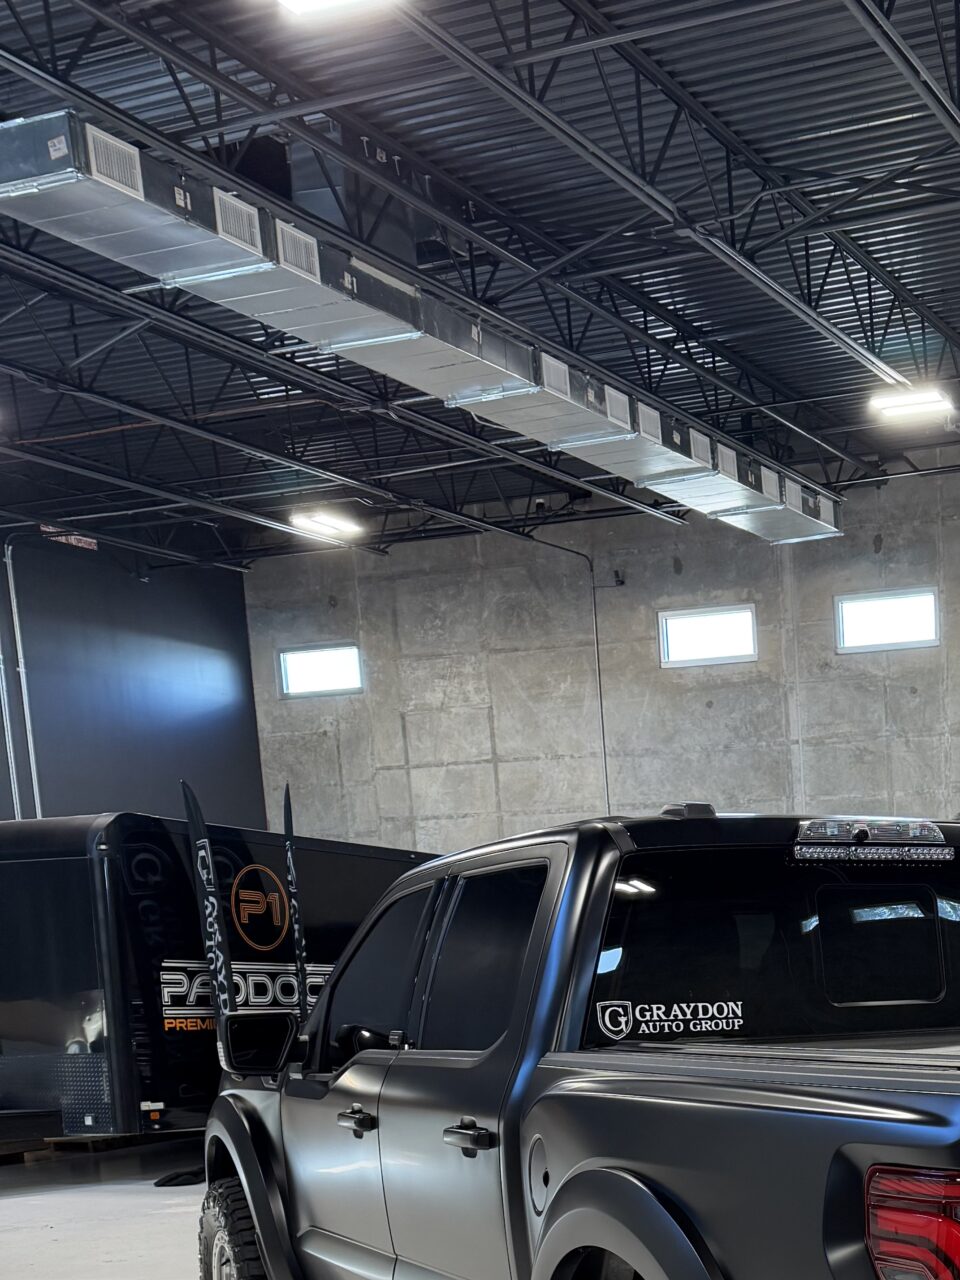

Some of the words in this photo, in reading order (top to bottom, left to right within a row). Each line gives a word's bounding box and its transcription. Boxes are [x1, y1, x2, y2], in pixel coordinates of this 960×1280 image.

[239, 889, 281, 926] P1
[160, 971, 329, 1006] PADDOC
[635, 1001, 743, 1021] GRAYDON
[164, 1018, 217, 1031] PREMI
[638, 1021, 684, 1034] AUTO
[689, 1019, 744, 1032] GROUP
